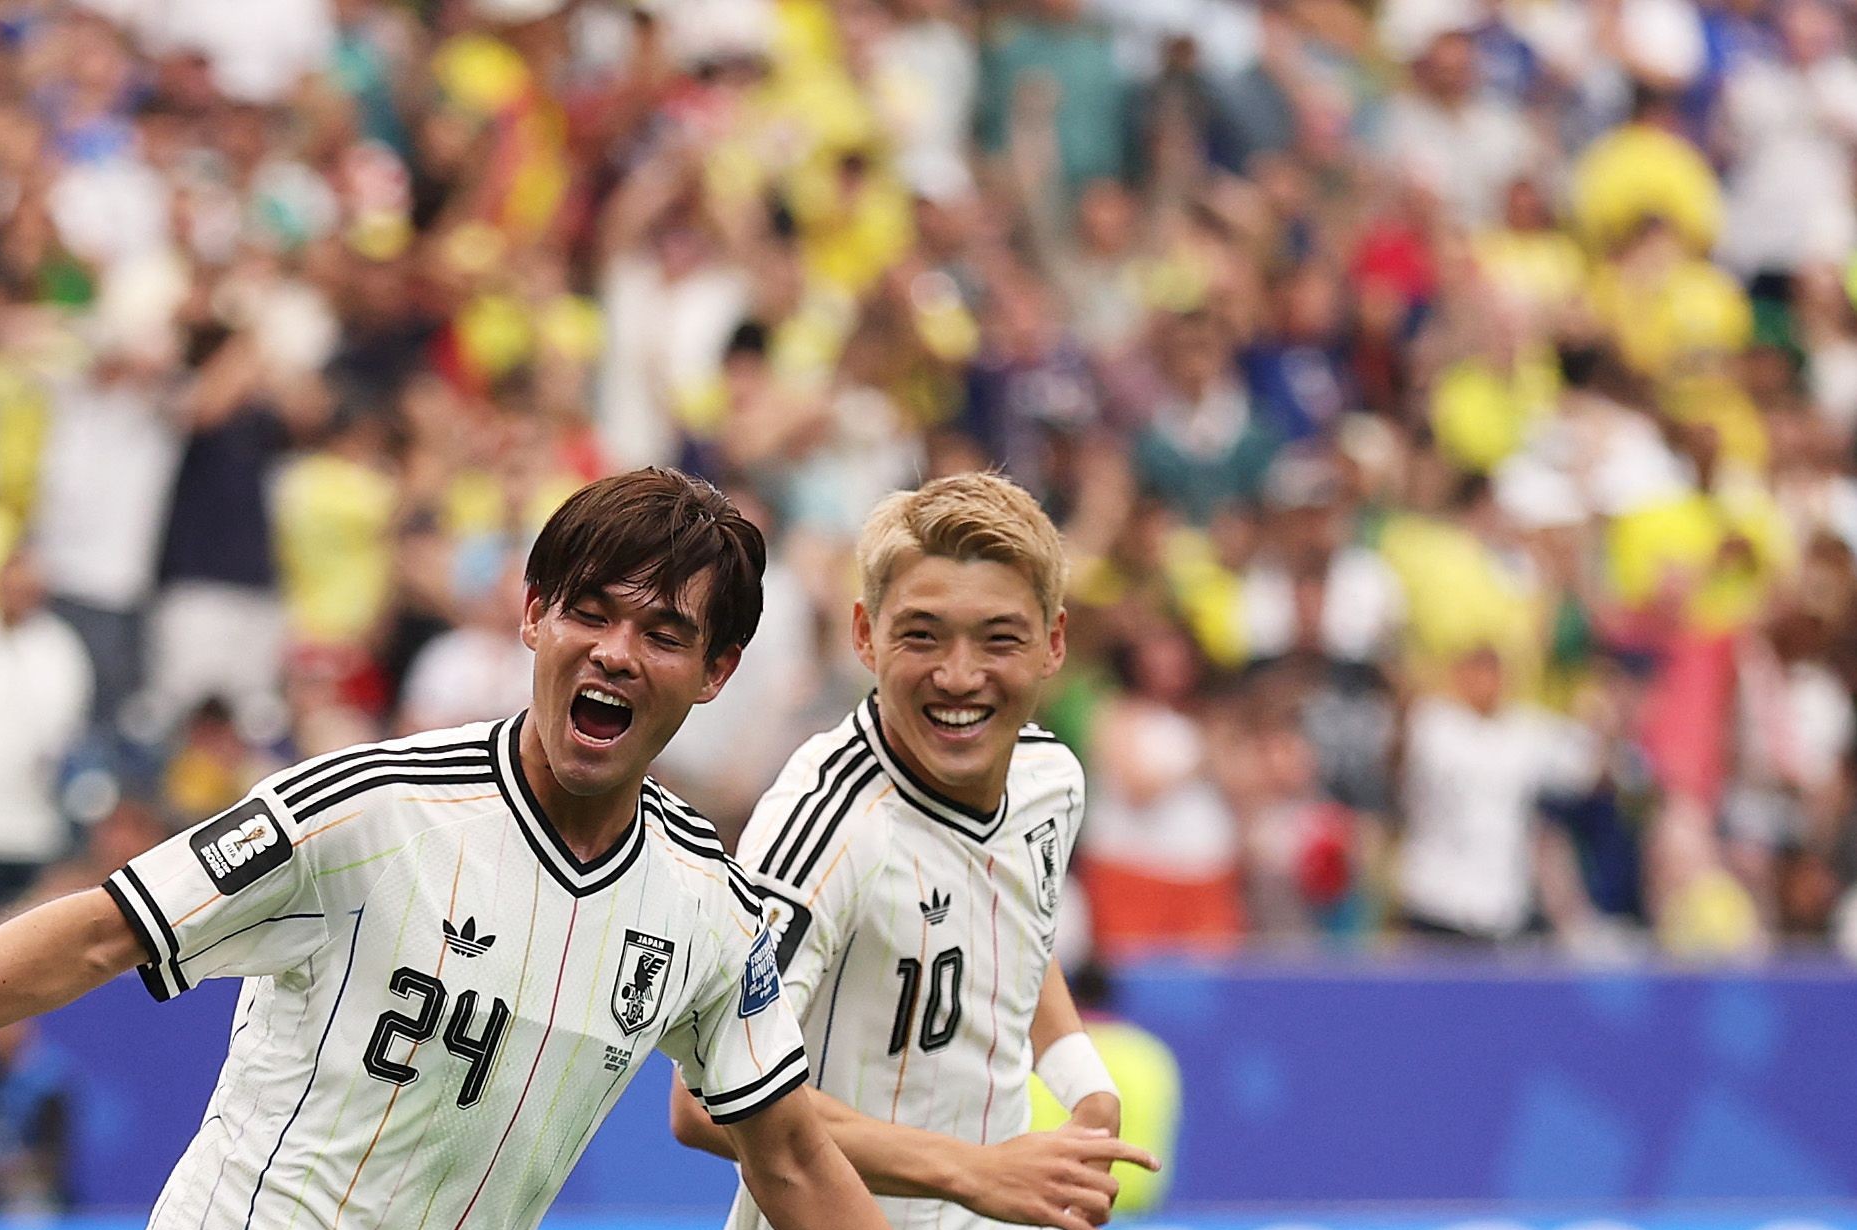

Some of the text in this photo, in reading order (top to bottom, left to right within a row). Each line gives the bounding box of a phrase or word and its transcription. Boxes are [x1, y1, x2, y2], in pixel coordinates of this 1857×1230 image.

[200, 845, 226, 879] 2026
[637, 935, 665, 950] JAPAN
[362, 966, 512, 1110] 24
[888, 946, 963, 1058] 10
